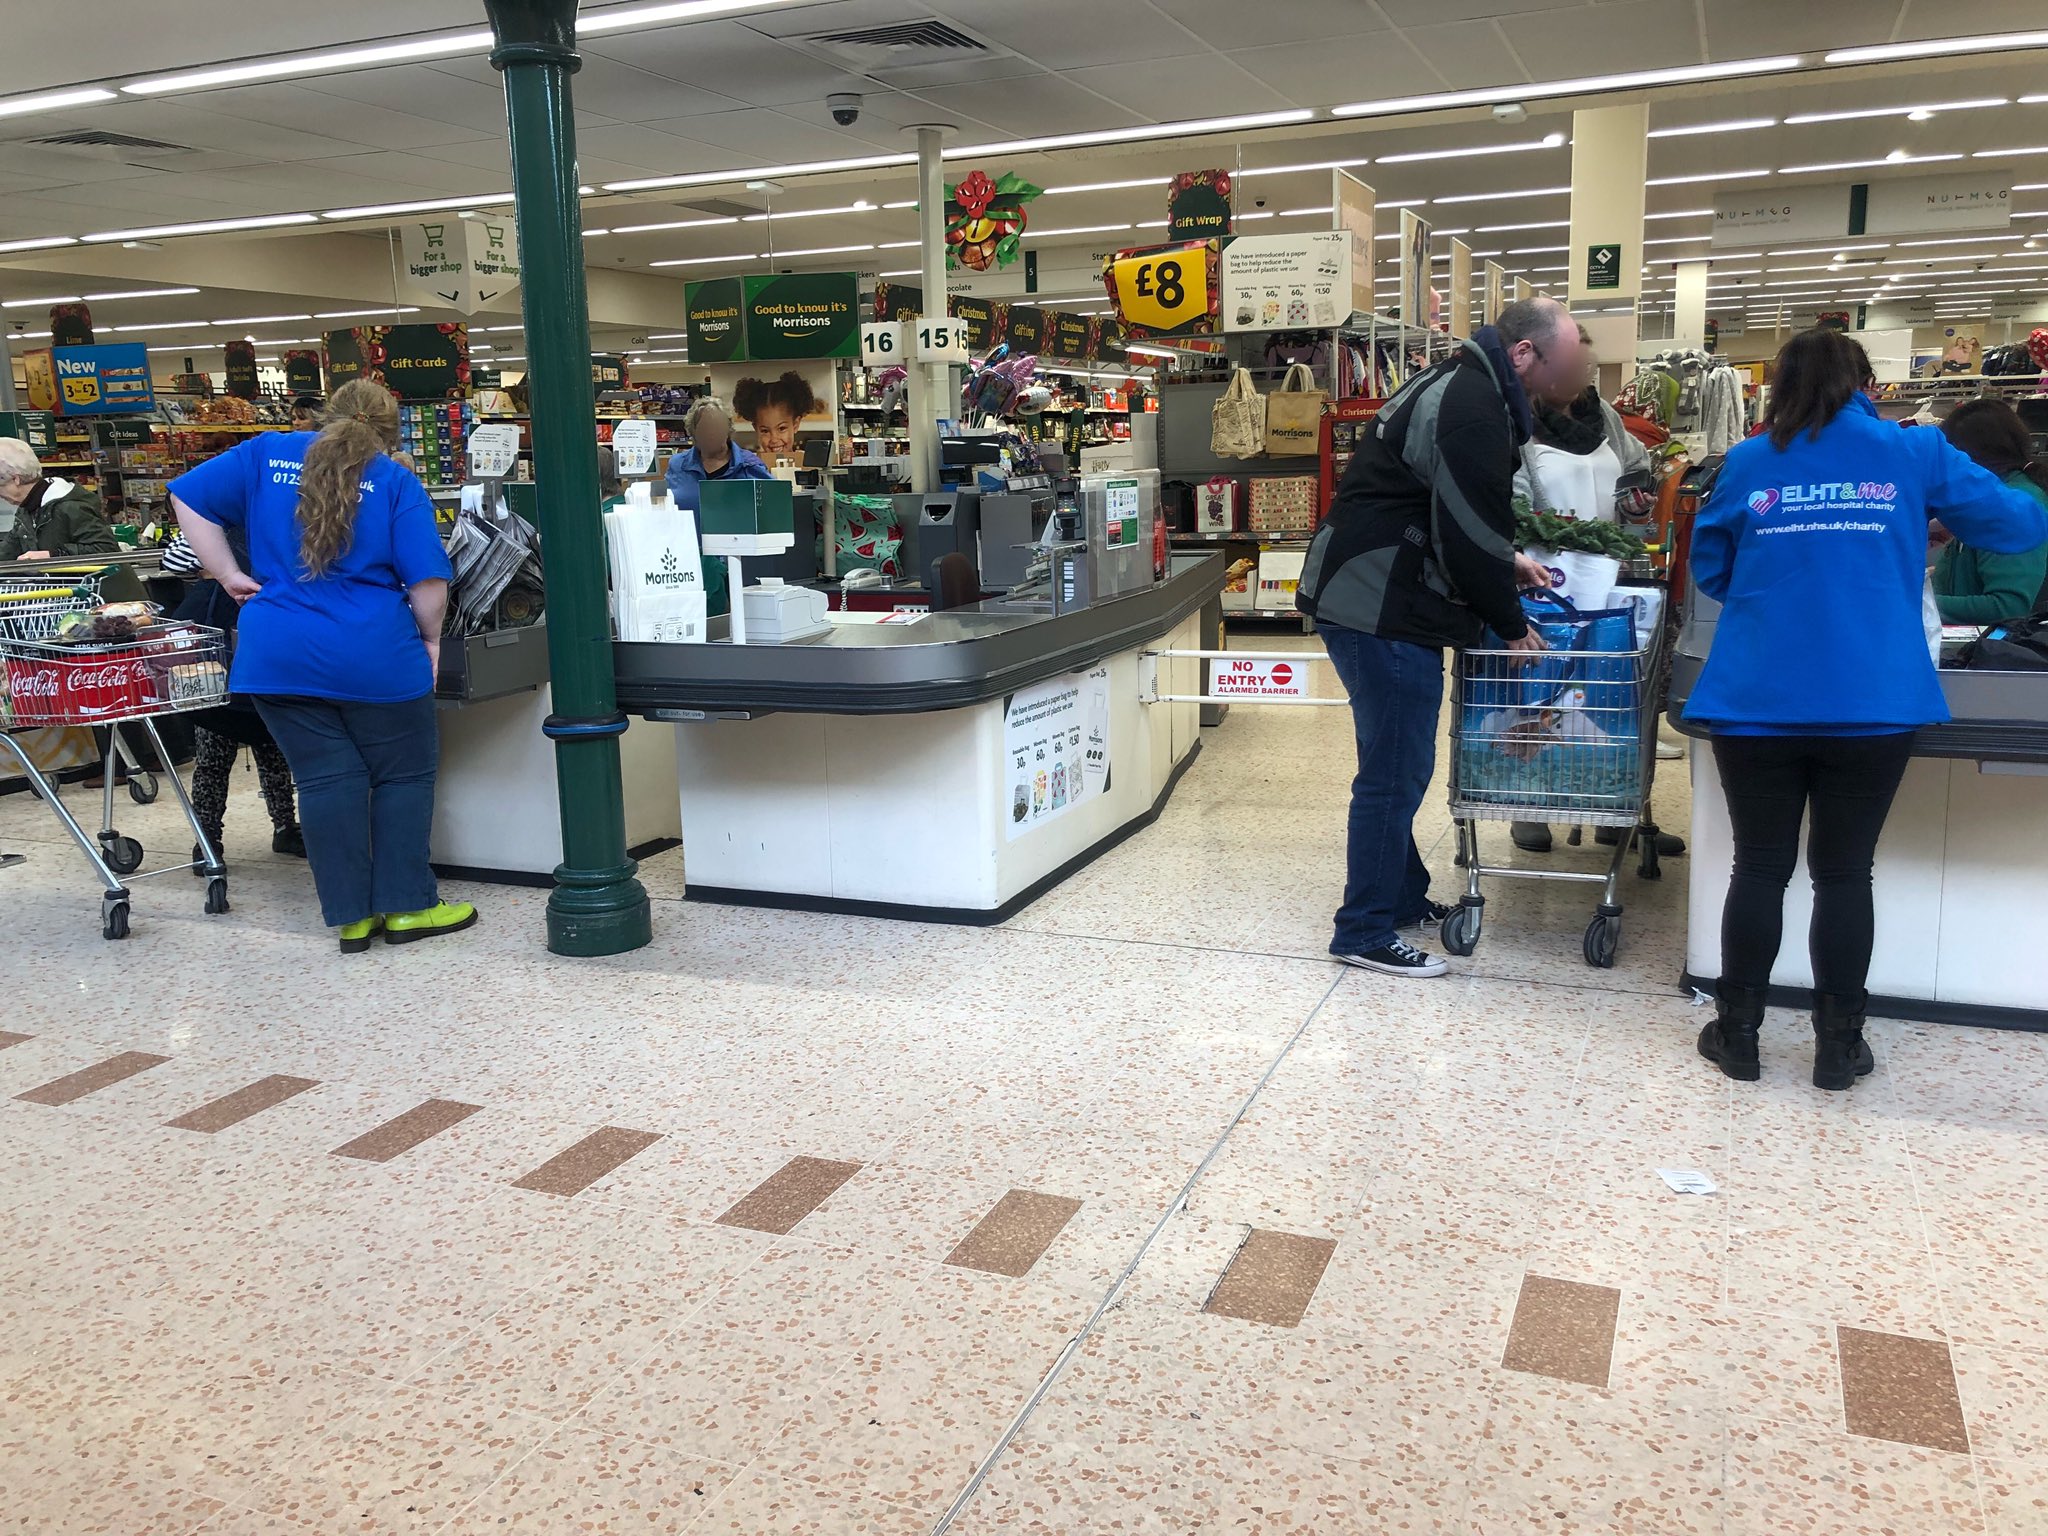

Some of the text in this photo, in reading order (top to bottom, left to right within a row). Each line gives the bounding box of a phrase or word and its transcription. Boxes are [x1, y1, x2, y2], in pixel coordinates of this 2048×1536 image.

[1175, 215, 1223, 228] Gift Wrap
[1331, 234, 1343, 242] 25p
[424, 252, 446, 262] For a
[486, 250, 506, 262] For a
[1255, 251, 1285, 259] introduced
[410, 261, 462, 277] bigger shop
[474, 260, 520, 277] bigger shop
[857, 271, 876, 279] ckers
[946, 284, 972, 292] ocolate
[1135, 260, 1185, 309] £8
[1265, 290, 1278, 298] 60p
[1291, 289, 1304, 297] 60p
[690, 307, 738, 320] Good to know it's
[755, 301, 847, 315] Good to know it's
[957, 305, 988, 321] Christmas
[699, 320, 730, 332] Morrisons
[773, 315, 831, 328] Morrisons
[1061, 320, 1085, 333] Christmas
[919, 327, 949, 349] 15
[1014, 324, 1035, 339] Gifting
[631, 336, 645, 344] Cola
[864, 332, 893, 353] 16
[954, 328, 968, 350] 15
[56, 359, 96, 375] New
[331, 361, 358, 373] Gift Cards
[390, 357, 447, 369] Gift Cards
[66, 384, 75, 398] 3
[82, 384, 97, 396] £2
[1342, 408, 1379, 417] Christma
[1271, 428, 1313, 438] Morrisons
[1070, 427, 1080, 453] Gifting
[1781, 481, 1898, 503] ELHT&me
[1781, 501, 1896, 514] your local hospital charity
[1755, 521, 1887, 535] www.elht.nhs.uk/charity
[645, 571, 695, 586] Morrisons
[1232, 661, 1254, 672] NO
[1217, 675, 1267, 686] ENTRY
[1217, 686, 1299, 695] ALARMED BARRIER
[1011, 708, 1018, 717] We
[1018, 706, 1028, 714] have
[1028, 697, 1047, 712] introduced
[1050, 696, 1061, 706] paper
[1071, 687, 1079, 697] help
[1011, 718, 1025, 729] reduce
[1032, 711, 1047, 721] amount
[1050, 705, 1062, 717] plastic
[1036, 748, 1046, 761] 60p
[1016, 756, 1026, 769] 30p
